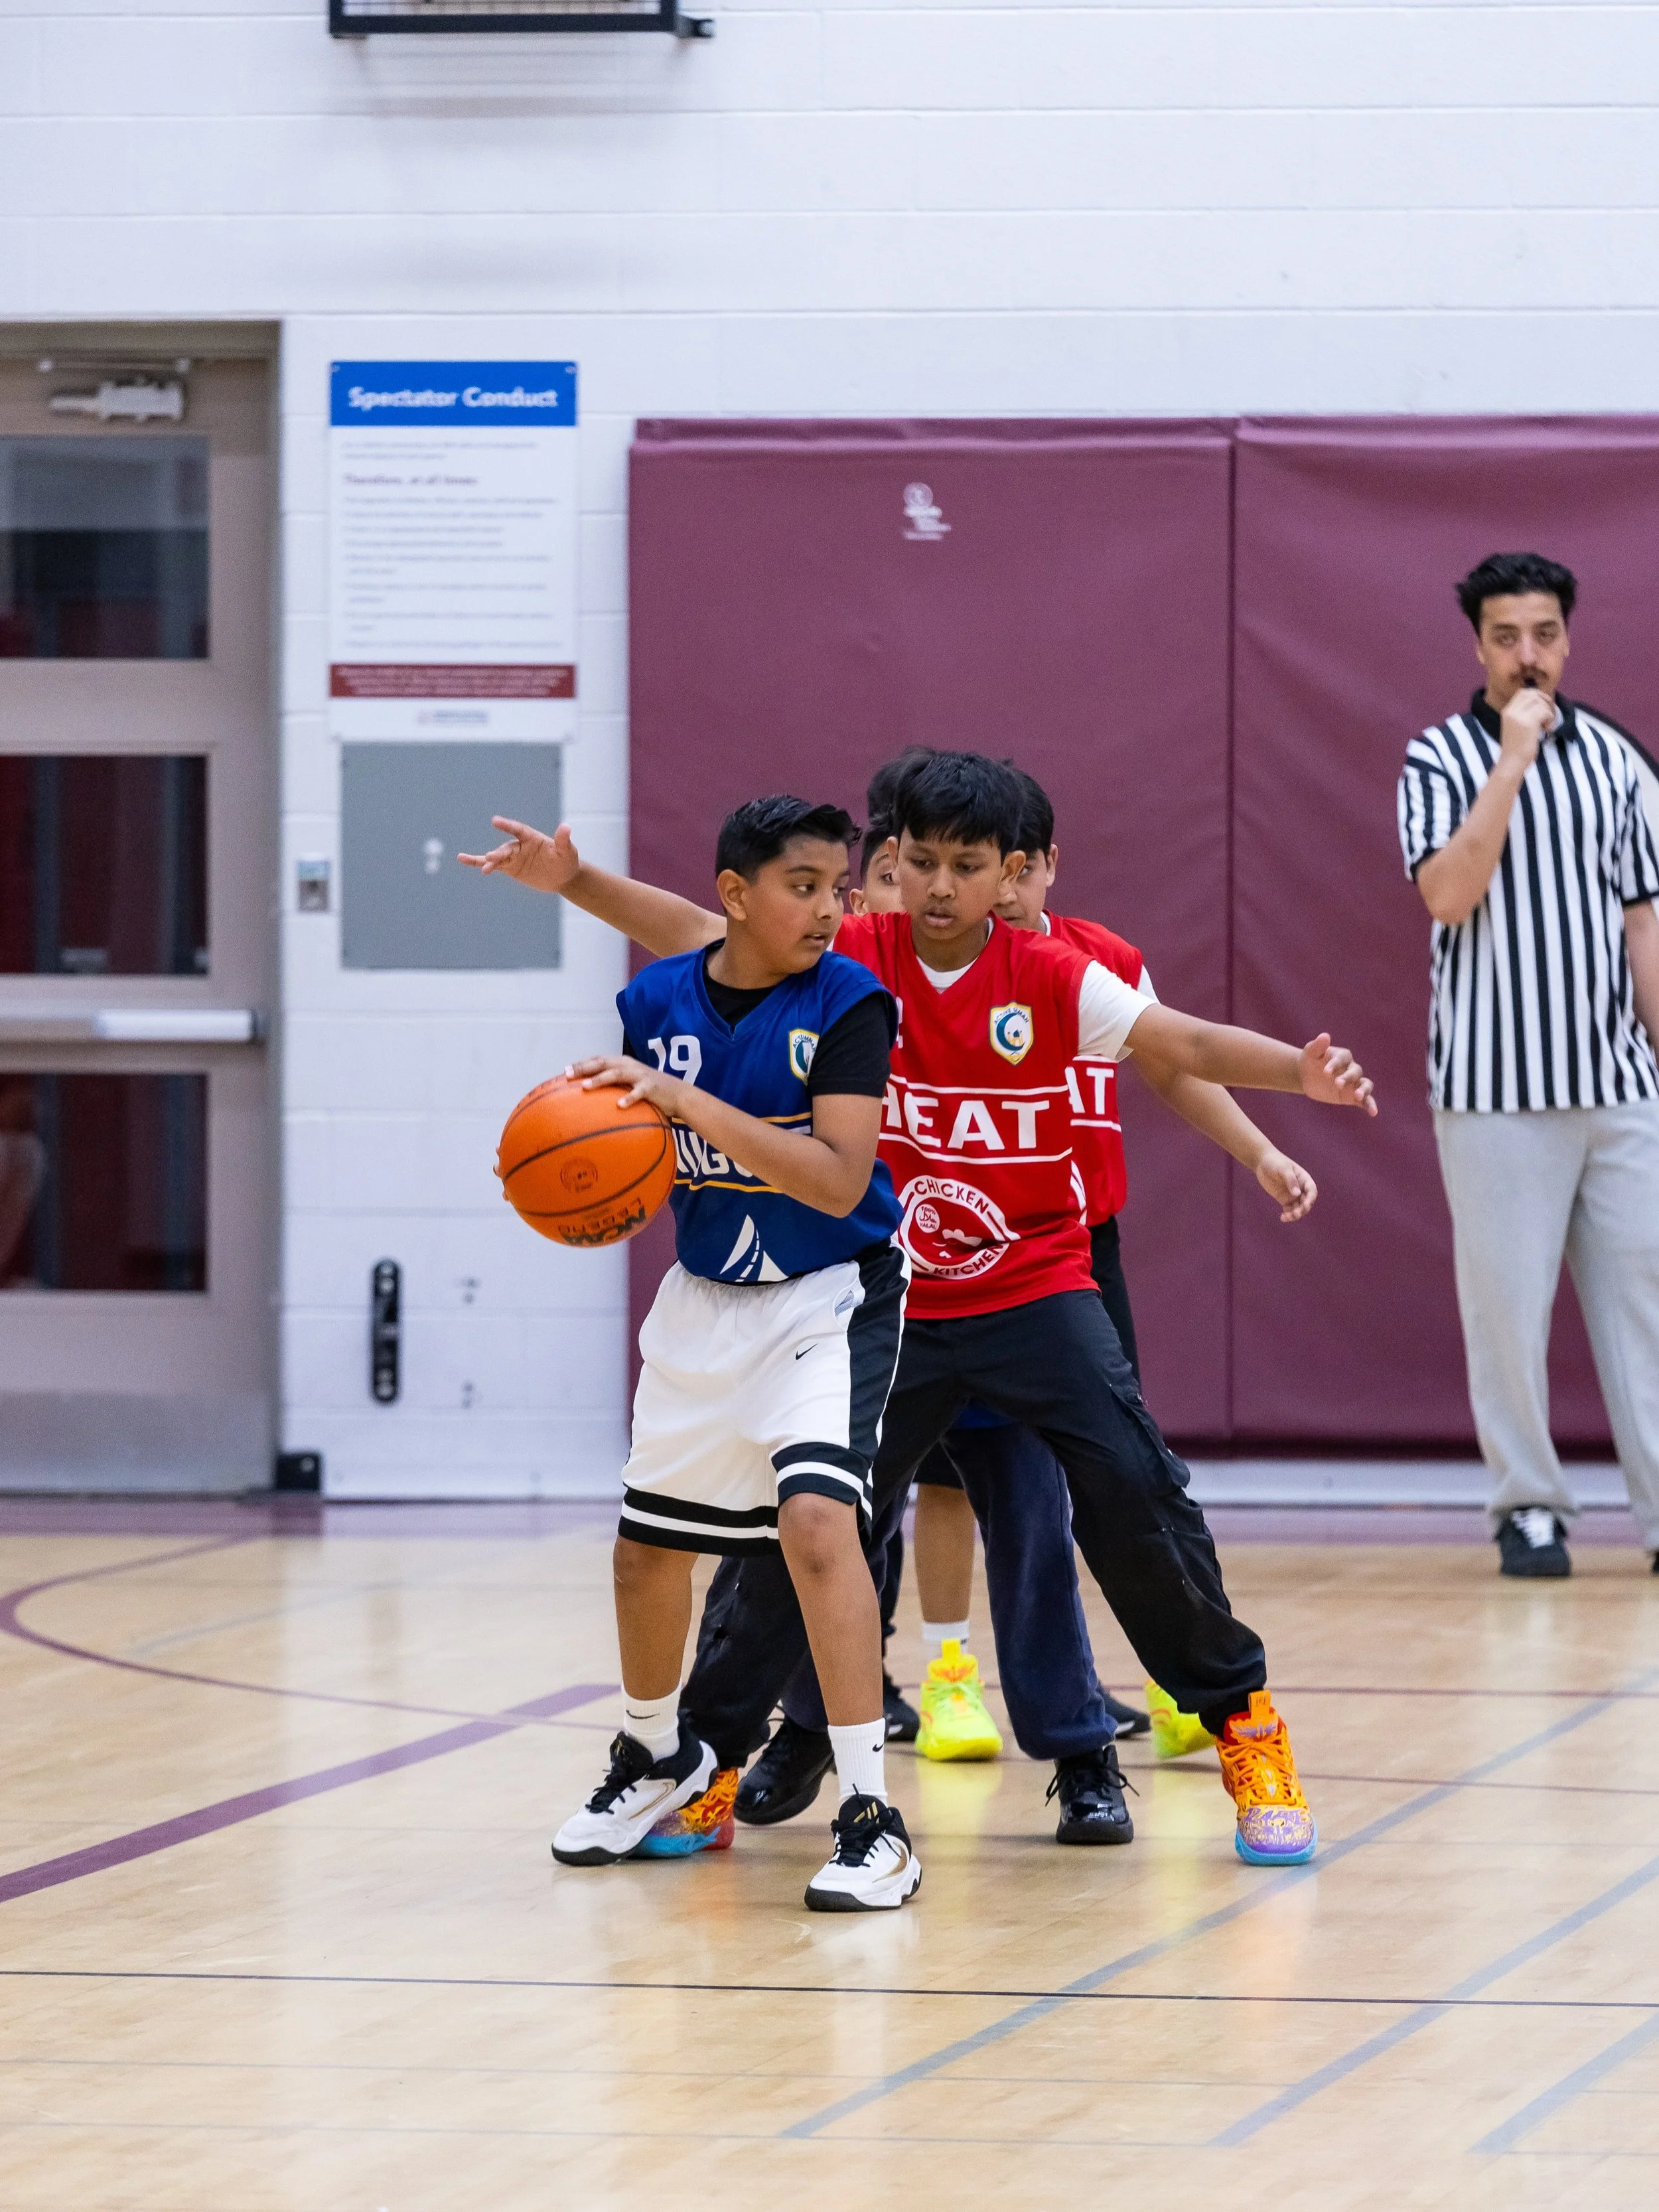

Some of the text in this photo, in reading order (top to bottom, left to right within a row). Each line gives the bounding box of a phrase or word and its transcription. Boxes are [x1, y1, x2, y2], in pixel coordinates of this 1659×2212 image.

[348, 386, 559, 411] Spectator Conduct
[648, 1035, 702, 1086] 19
[914, 1179, 989, 1214] CHICKEN
[933, 1245, 1005, 1276] KITCHEN
